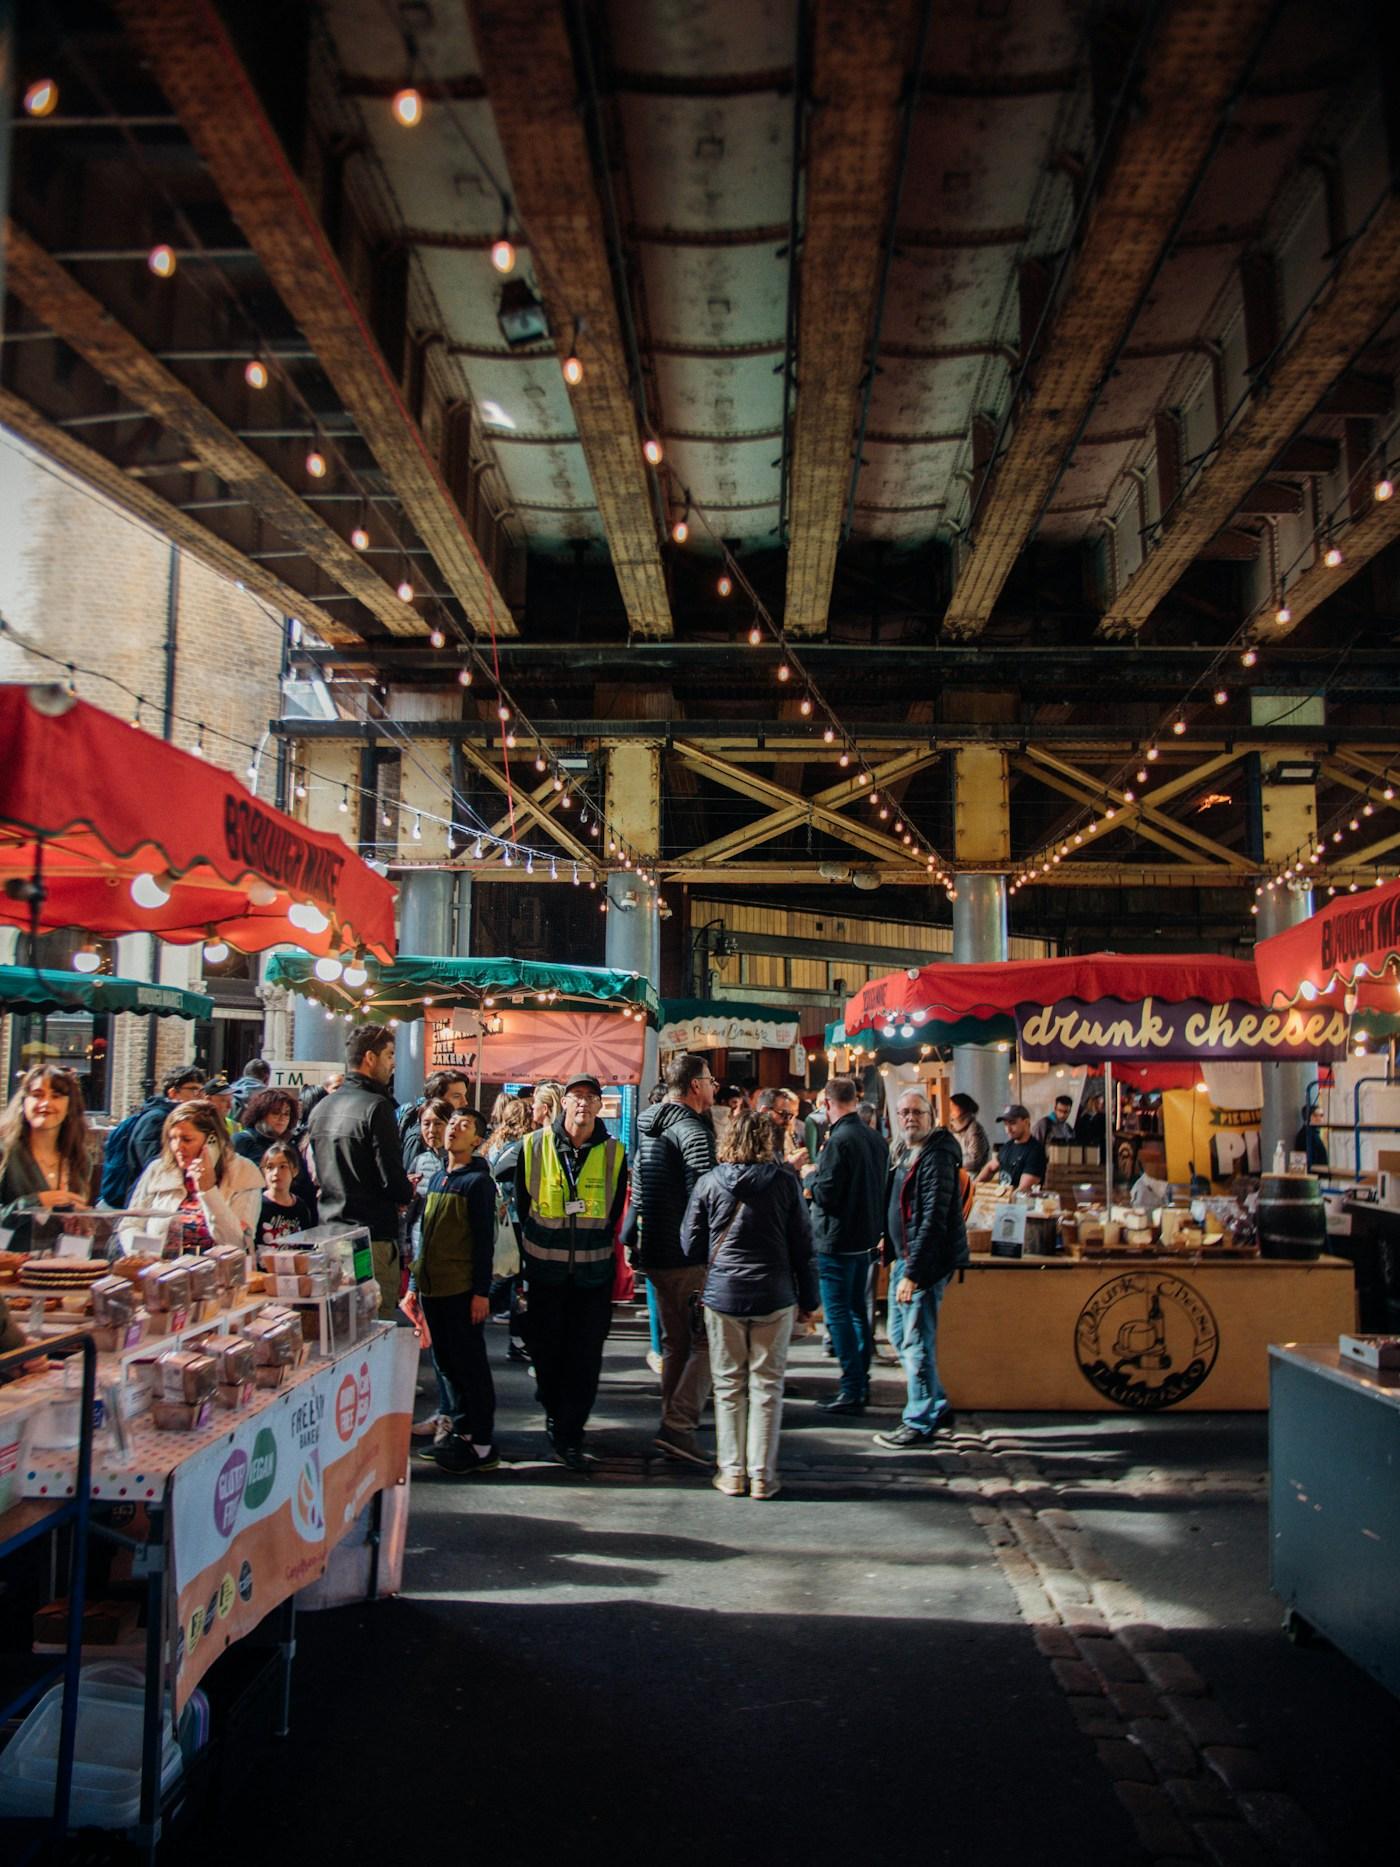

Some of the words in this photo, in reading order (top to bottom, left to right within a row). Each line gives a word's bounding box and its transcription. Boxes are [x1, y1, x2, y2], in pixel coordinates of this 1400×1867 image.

[1022, 997, 1173, 1049] drunk
[1185, 1000, 1346, 1048] cheeses
[432, 1040, 454, 1054] TREE
[432, 1052, 475, 1067] BAKERY
